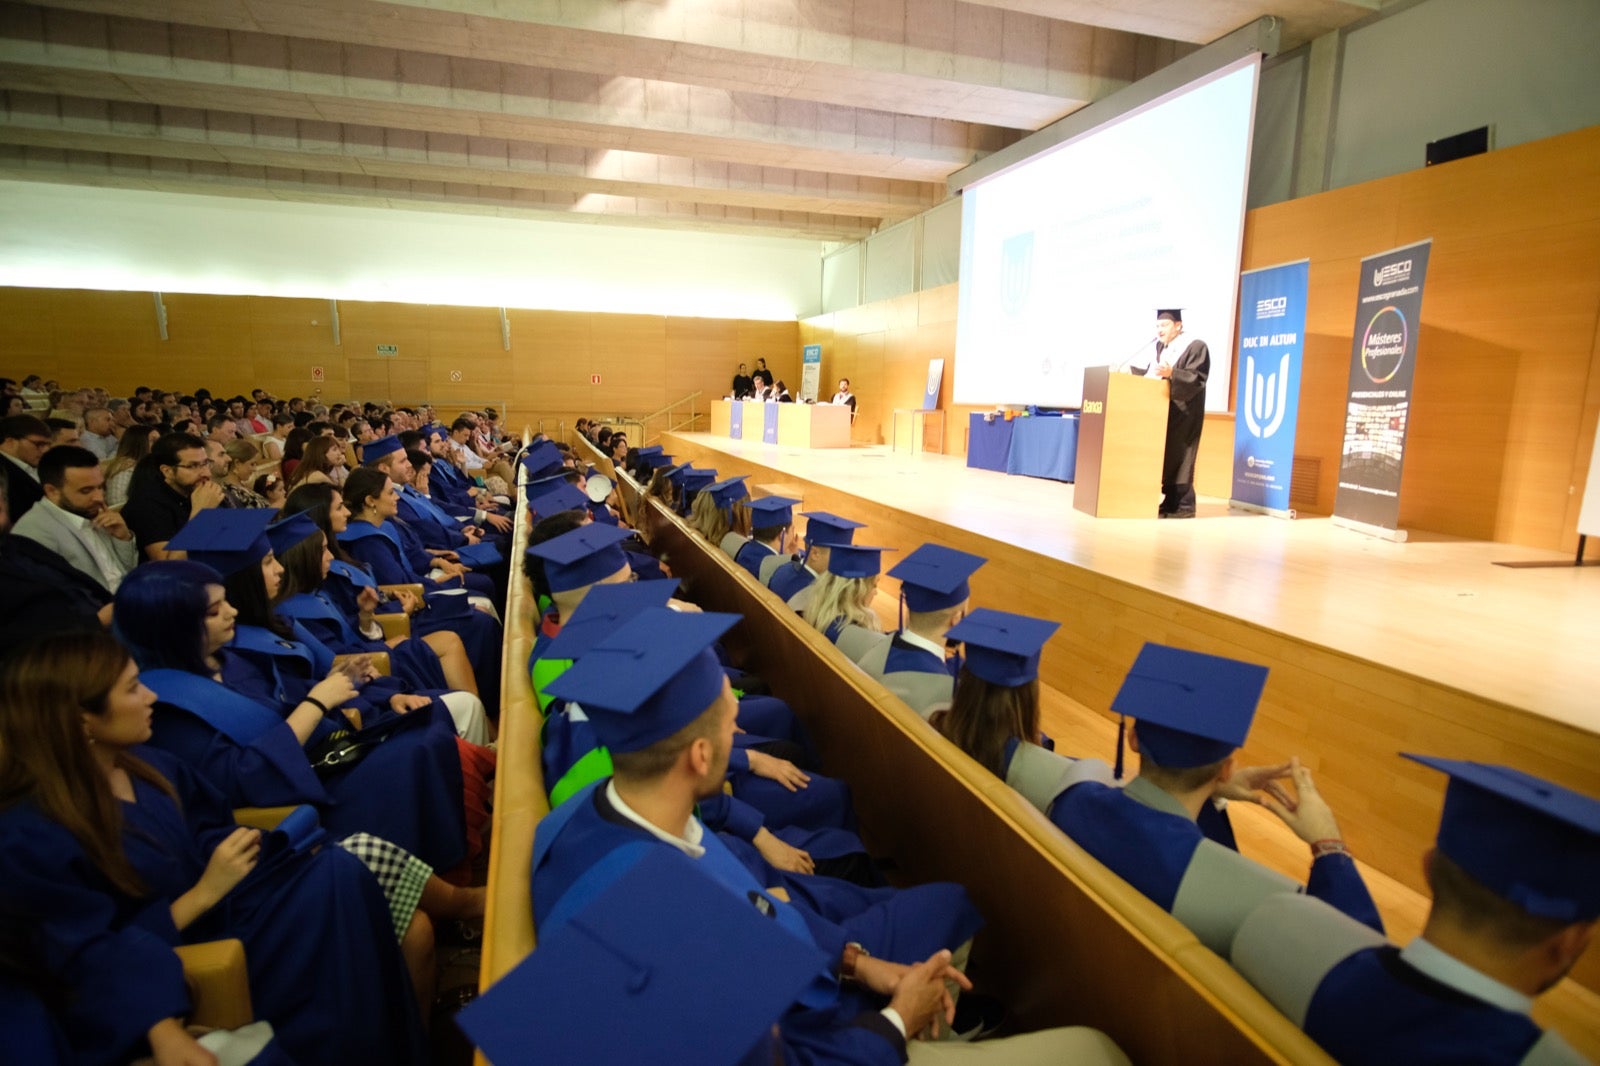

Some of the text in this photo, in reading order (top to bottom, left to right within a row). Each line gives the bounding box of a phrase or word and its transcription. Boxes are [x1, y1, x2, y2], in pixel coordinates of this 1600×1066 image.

[1382, 260, 1412, 278] ESCO
[1257, 297, 1287, 312] ESCO
[1243, 333, 1297, 348] DUC IN ALTUM
[1368, 333, 1402, 346] Másteres
